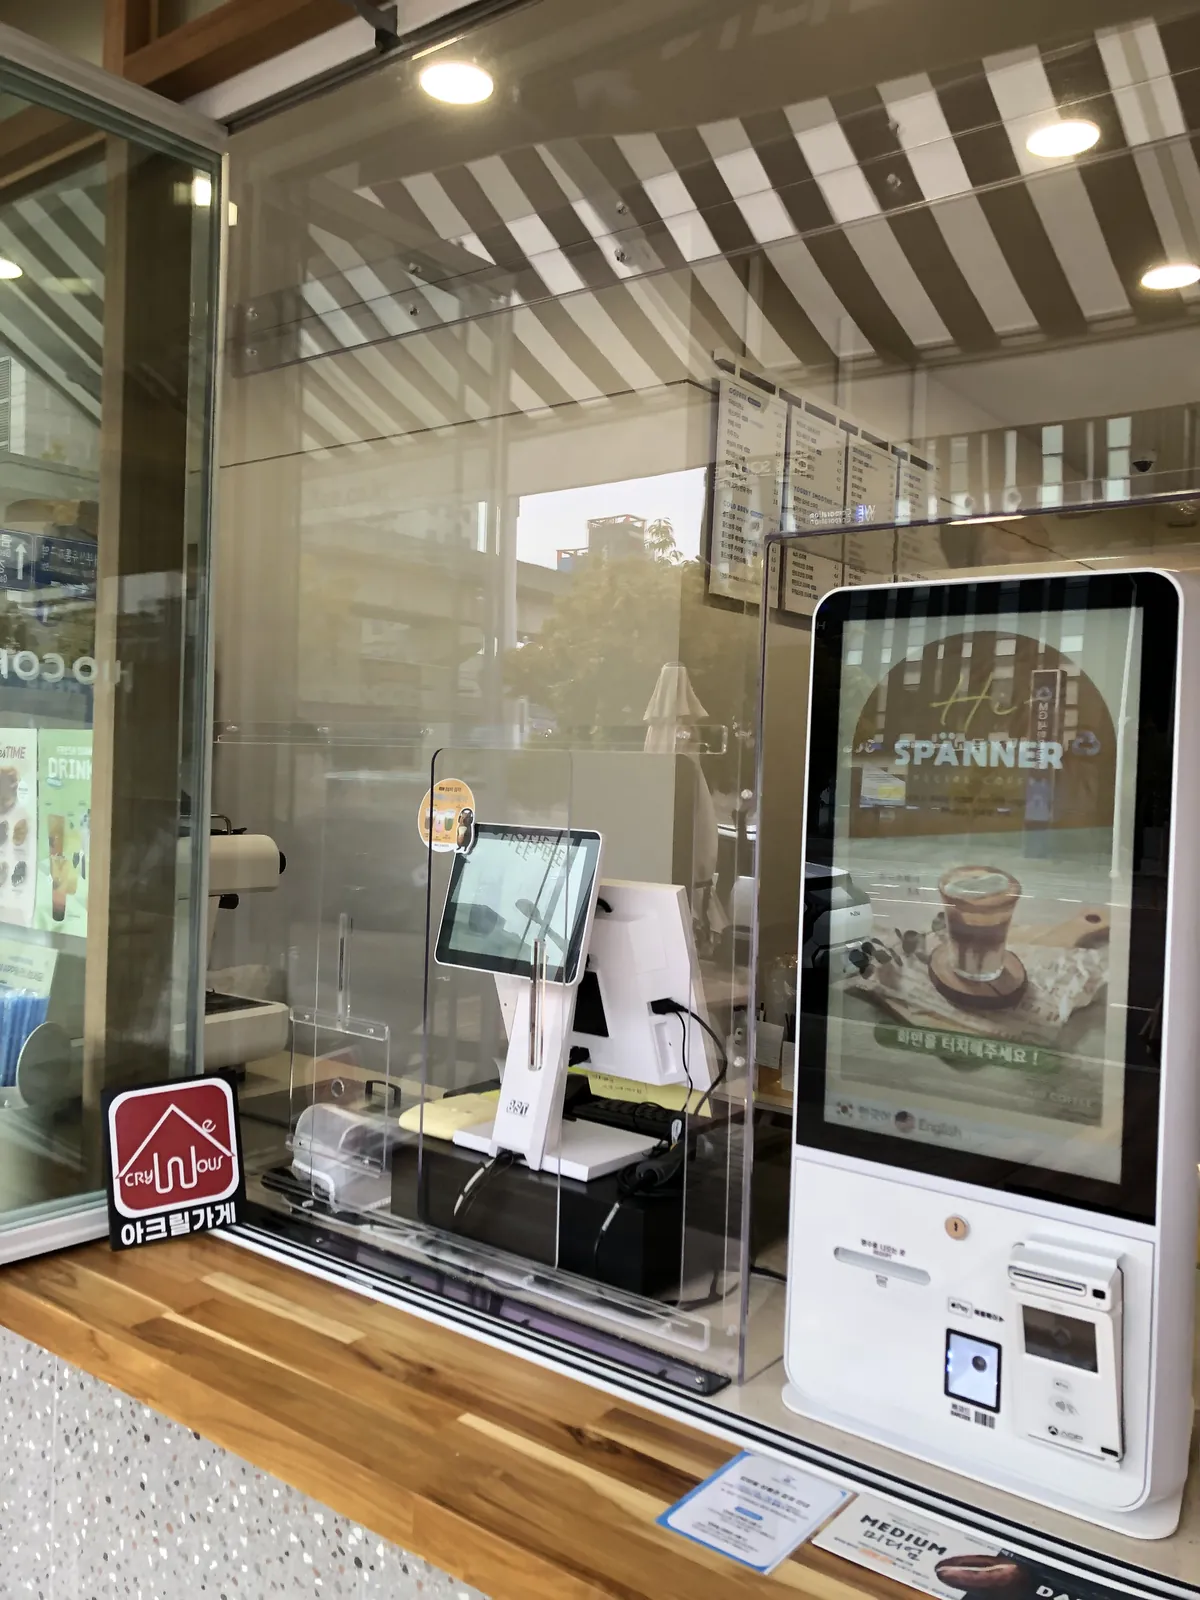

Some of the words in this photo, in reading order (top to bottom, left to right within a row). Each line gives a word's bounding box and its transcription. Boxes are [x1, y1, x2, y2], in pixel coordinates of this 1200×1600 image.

[893, 732, 1064, 770] SPÄNNER
[120, 1201, 237, 1246] 아크릴가게
[859, 1514, 948, 1556] MEDIUM
